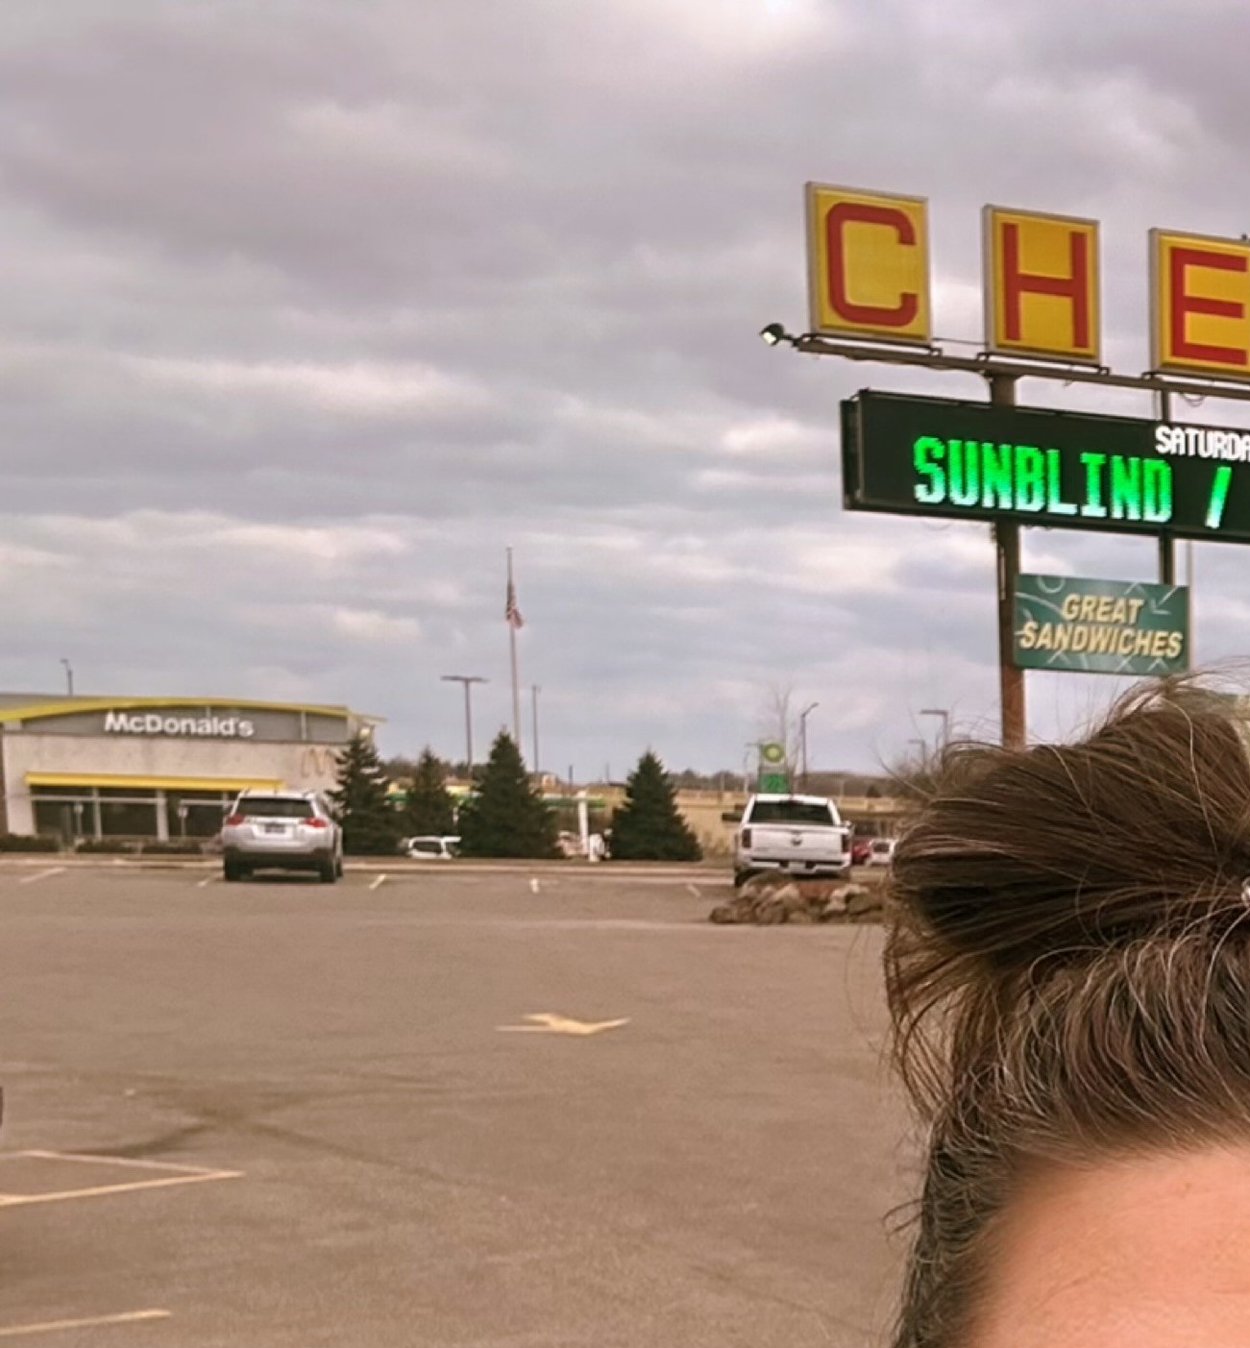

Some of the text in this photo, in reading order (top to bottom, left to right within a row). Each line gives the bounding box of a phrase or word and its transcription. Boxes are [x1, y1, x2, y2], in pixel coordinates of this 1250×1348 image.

[913, 436, 1172, 523] SUNBLIND
[1205, 466, 1232, 529] /
[1062, 593, 1145, 625] GREAT
[1020, 620, 1184, 658] SANDWICHES
[104, 710, 255, 738] McDonald's
